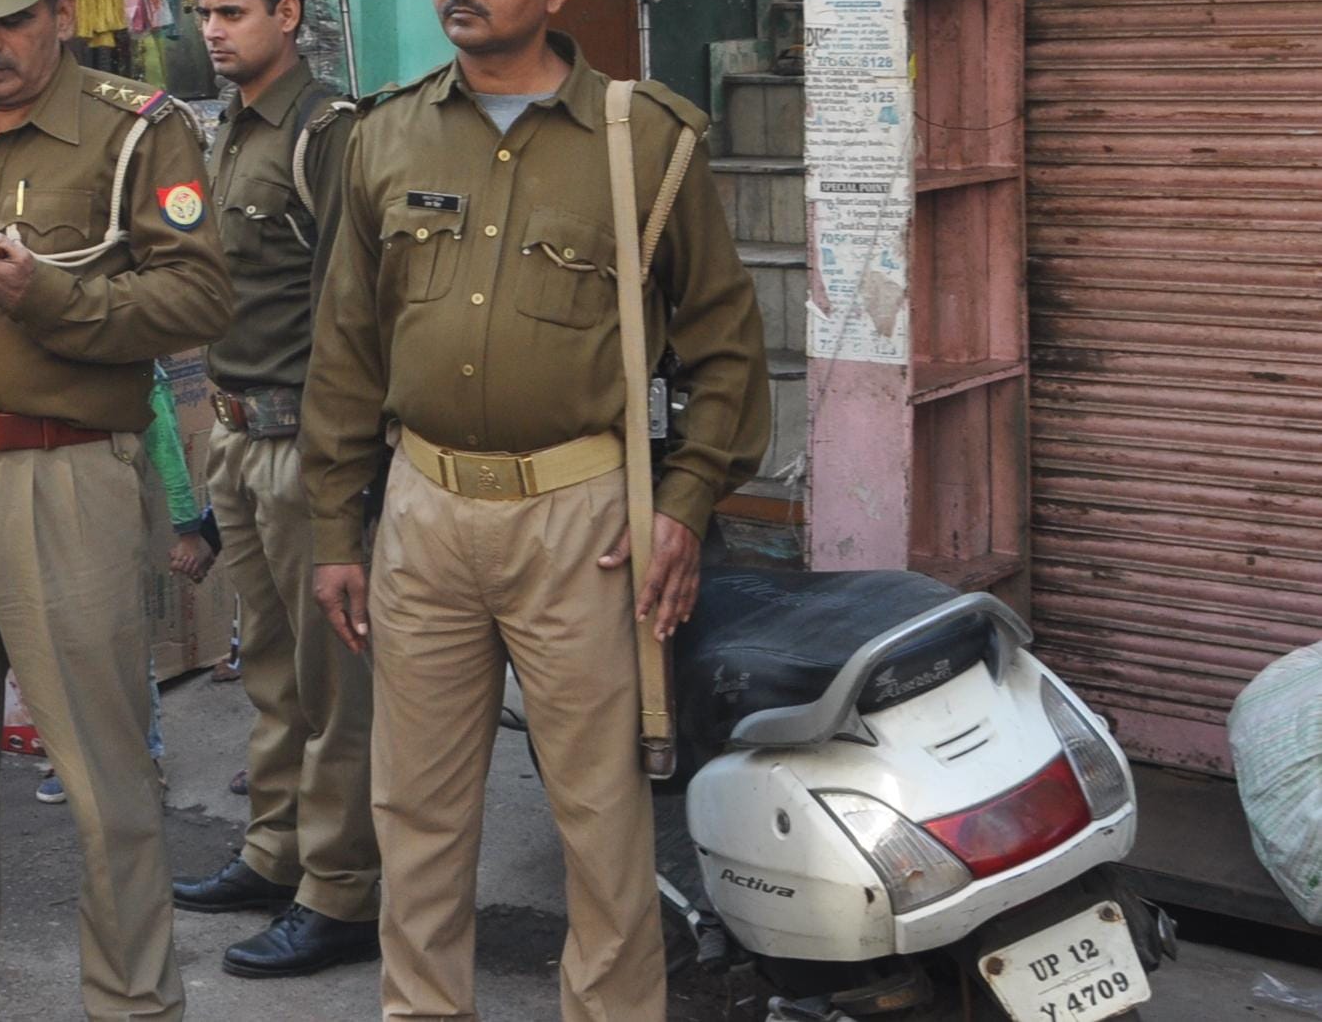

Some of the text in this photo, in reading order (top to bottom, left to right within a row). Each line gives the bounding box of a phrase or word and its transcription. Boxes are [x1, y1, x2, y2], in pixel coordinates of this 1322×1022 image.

[720, 868, 796, 898] Activa
[1028, 938, 1100, 982] UP 12
[1067, 971, 1129, 1012] 4709
